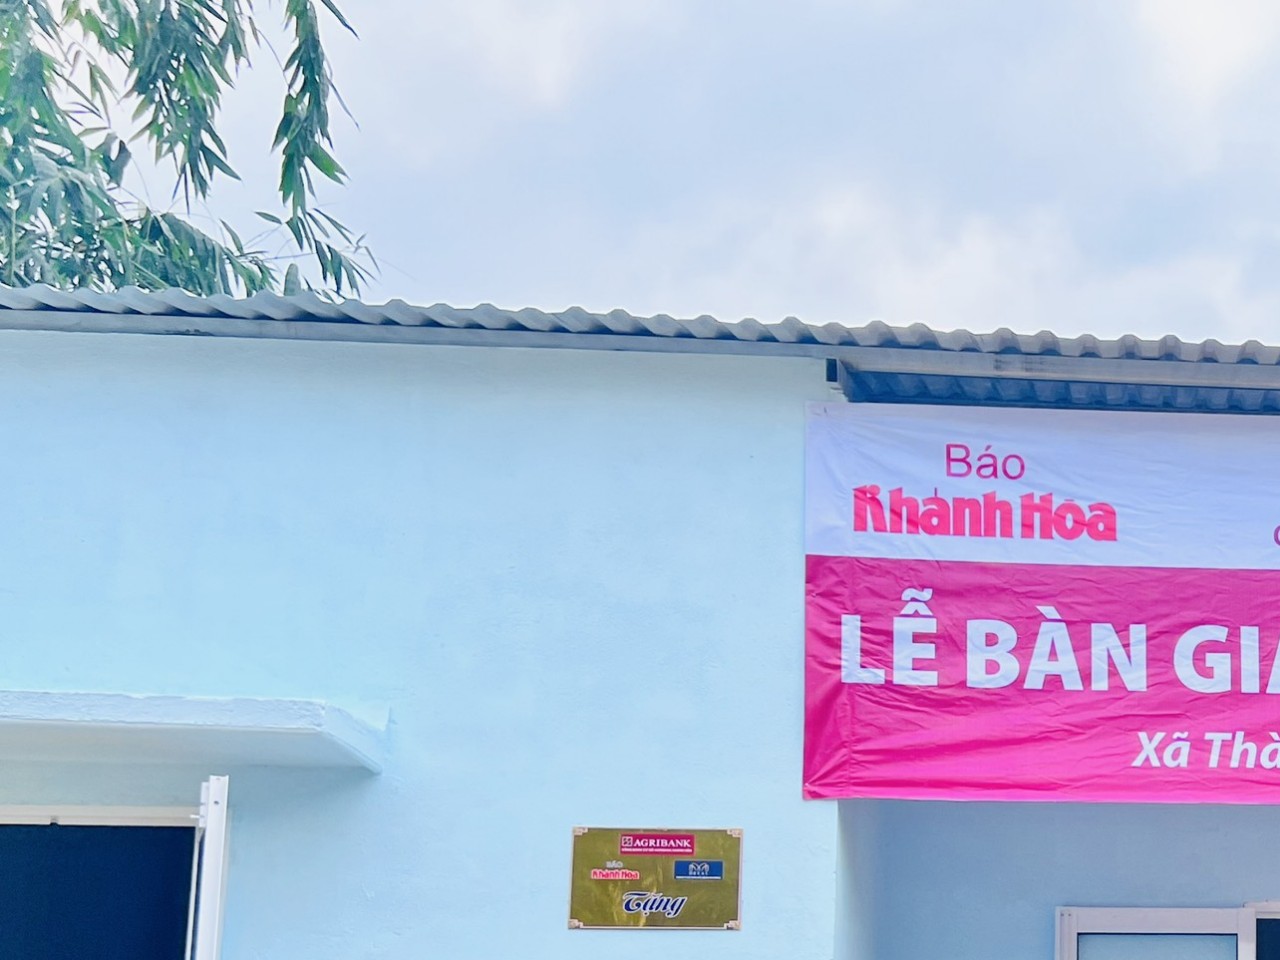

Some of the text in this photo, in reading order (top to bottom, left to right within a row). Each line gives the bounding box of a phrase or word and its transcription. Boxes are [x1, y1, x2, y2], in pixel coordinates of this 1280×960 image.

[945, 444, 1026, 480] Báo
[838, 587, 939, 688] LỄ
[966, 605, 1148, 692] BÀN
[1131, 731, 1191, 768] Xã
[633, 838, 692, 848] AGRIBANK
[622, 891, 688, 918] Tặng
